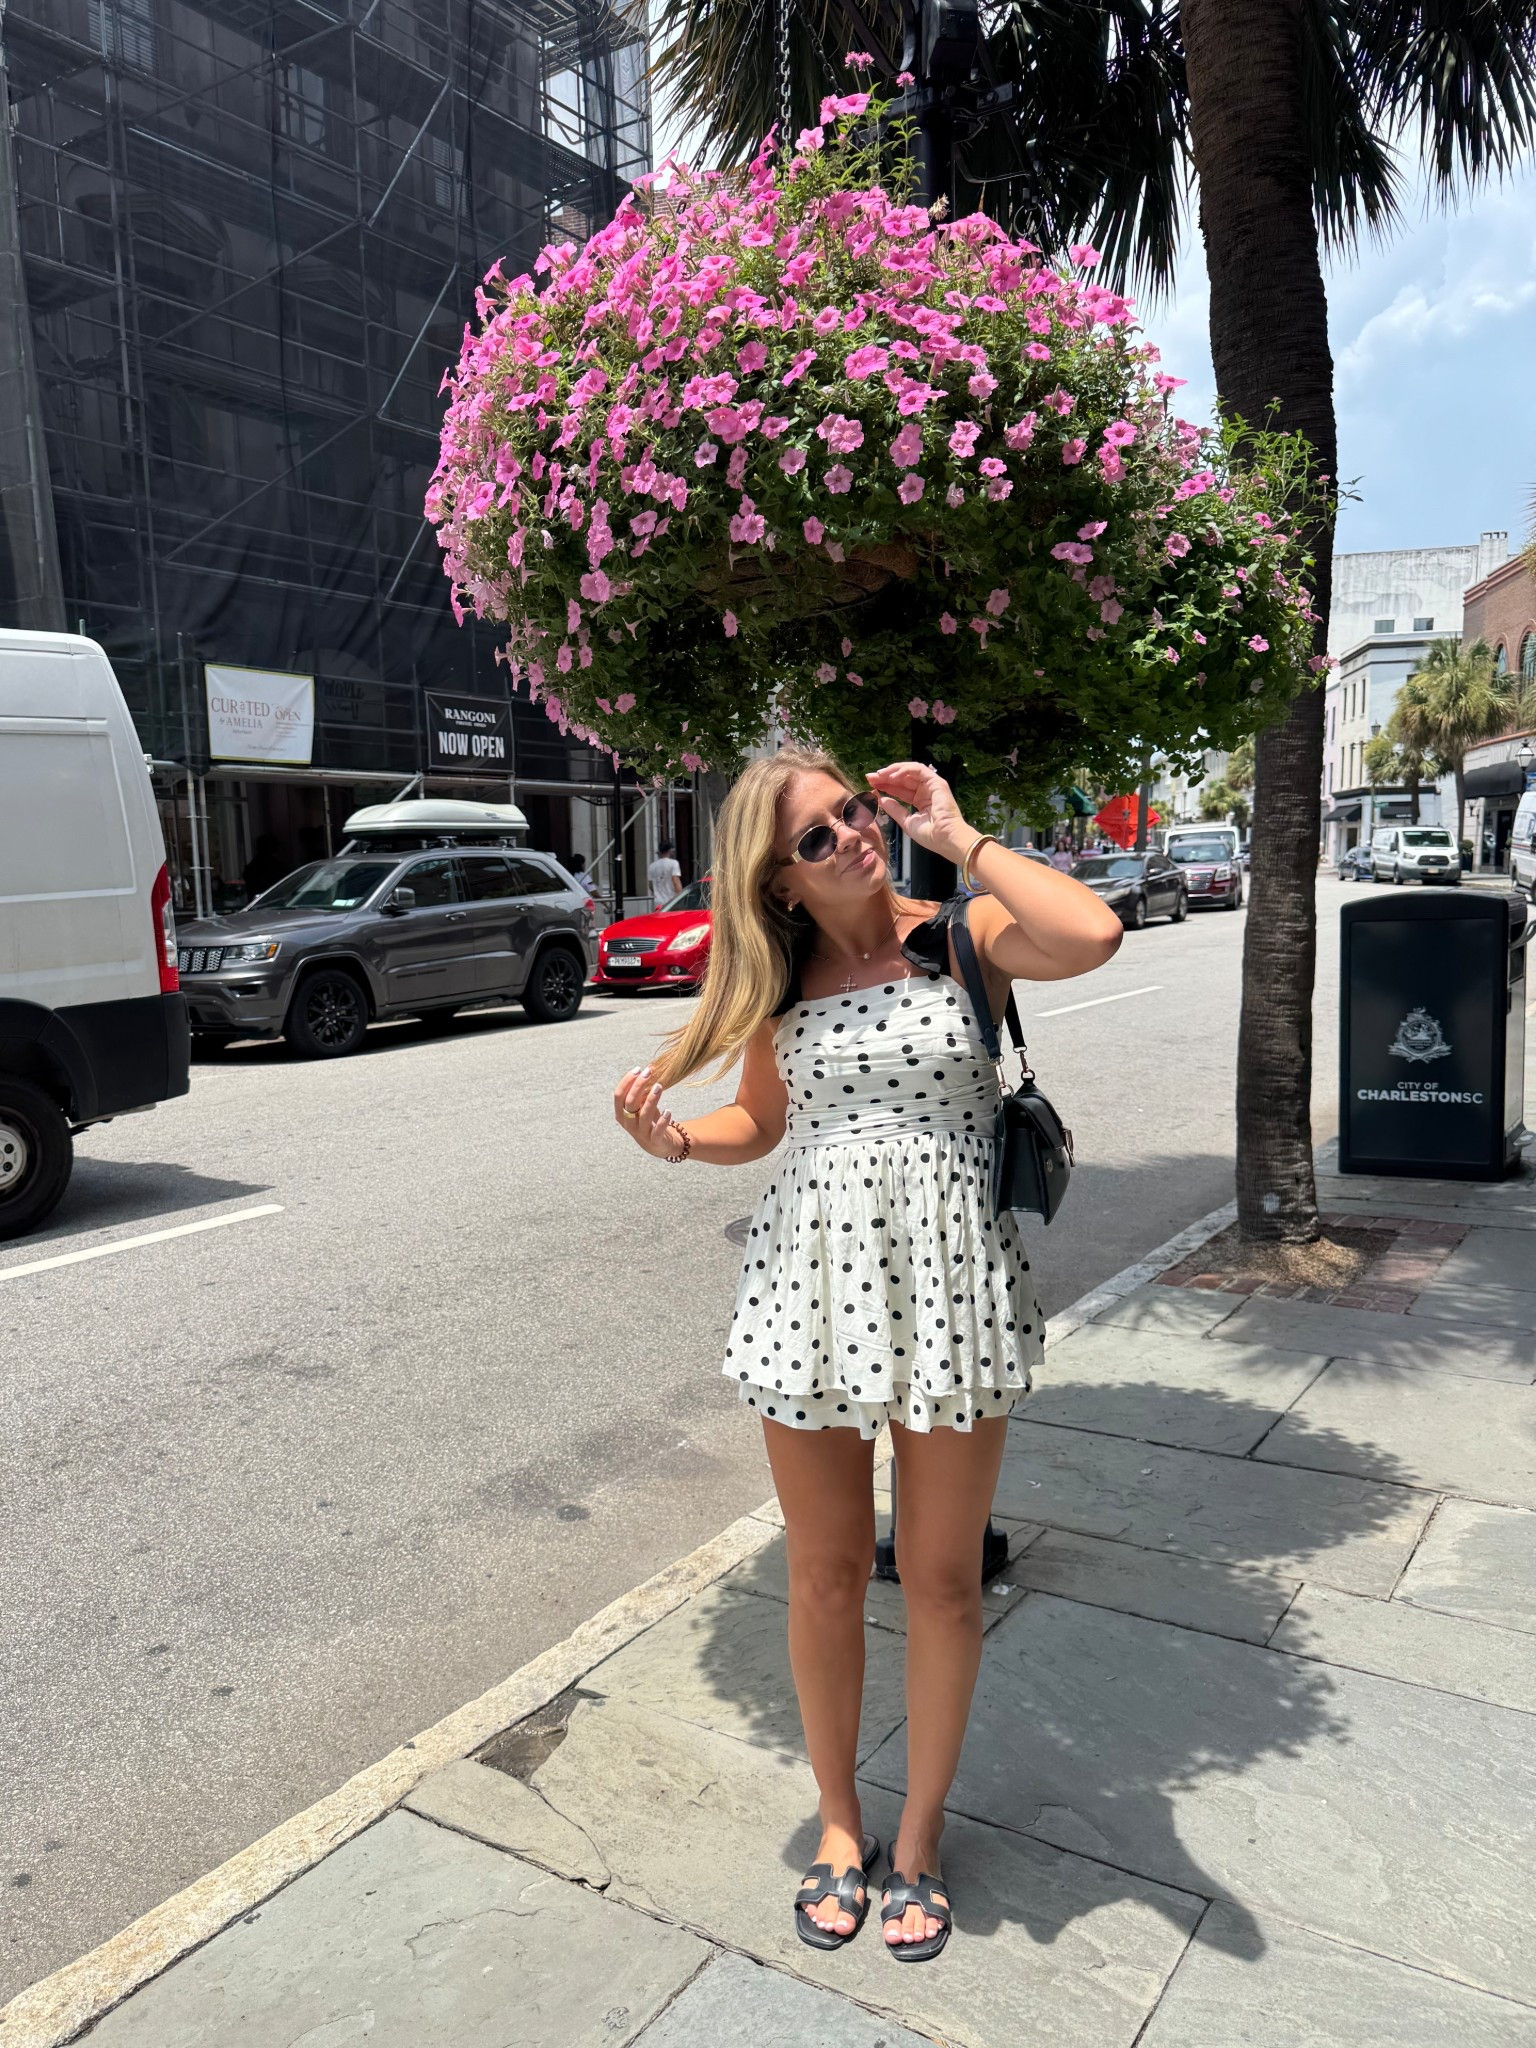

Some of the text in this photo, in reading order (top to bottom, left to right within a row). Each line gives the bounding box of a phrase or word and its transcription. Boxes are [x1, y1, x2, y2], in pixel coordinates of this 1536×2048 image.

[274, 710, 301, 721] OPEN
[444, 708, 496, 724] RANGONI
[226, 717, 263, 729] AMELIA
[438, 731, 505, 758] NOW OPEN
[1397, 1081, 1440, 1091] CITY OF
[1357, 1089, 1483, 1104] CHARLESTONSC
